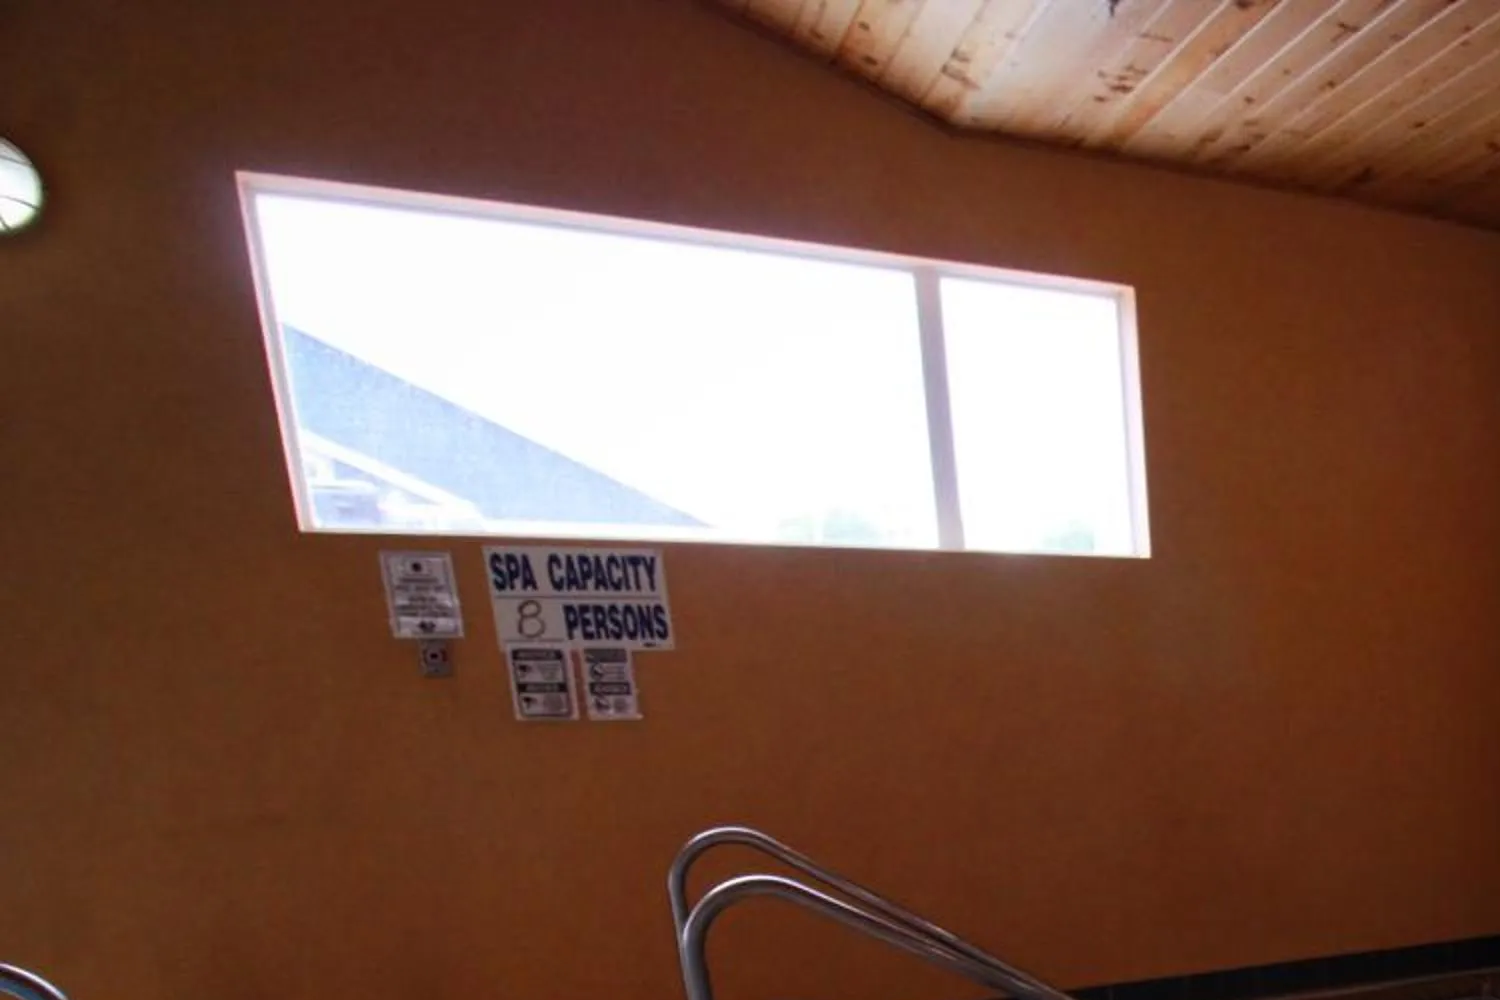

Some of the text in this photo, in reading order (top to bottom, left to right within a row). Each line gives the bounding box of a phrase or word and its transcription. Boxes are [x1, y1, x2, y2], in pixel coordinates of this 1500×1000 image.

[489, 552, 657, 592] SPA CAPACITY
[516, 599, 669, 641] 8 PERSONS
